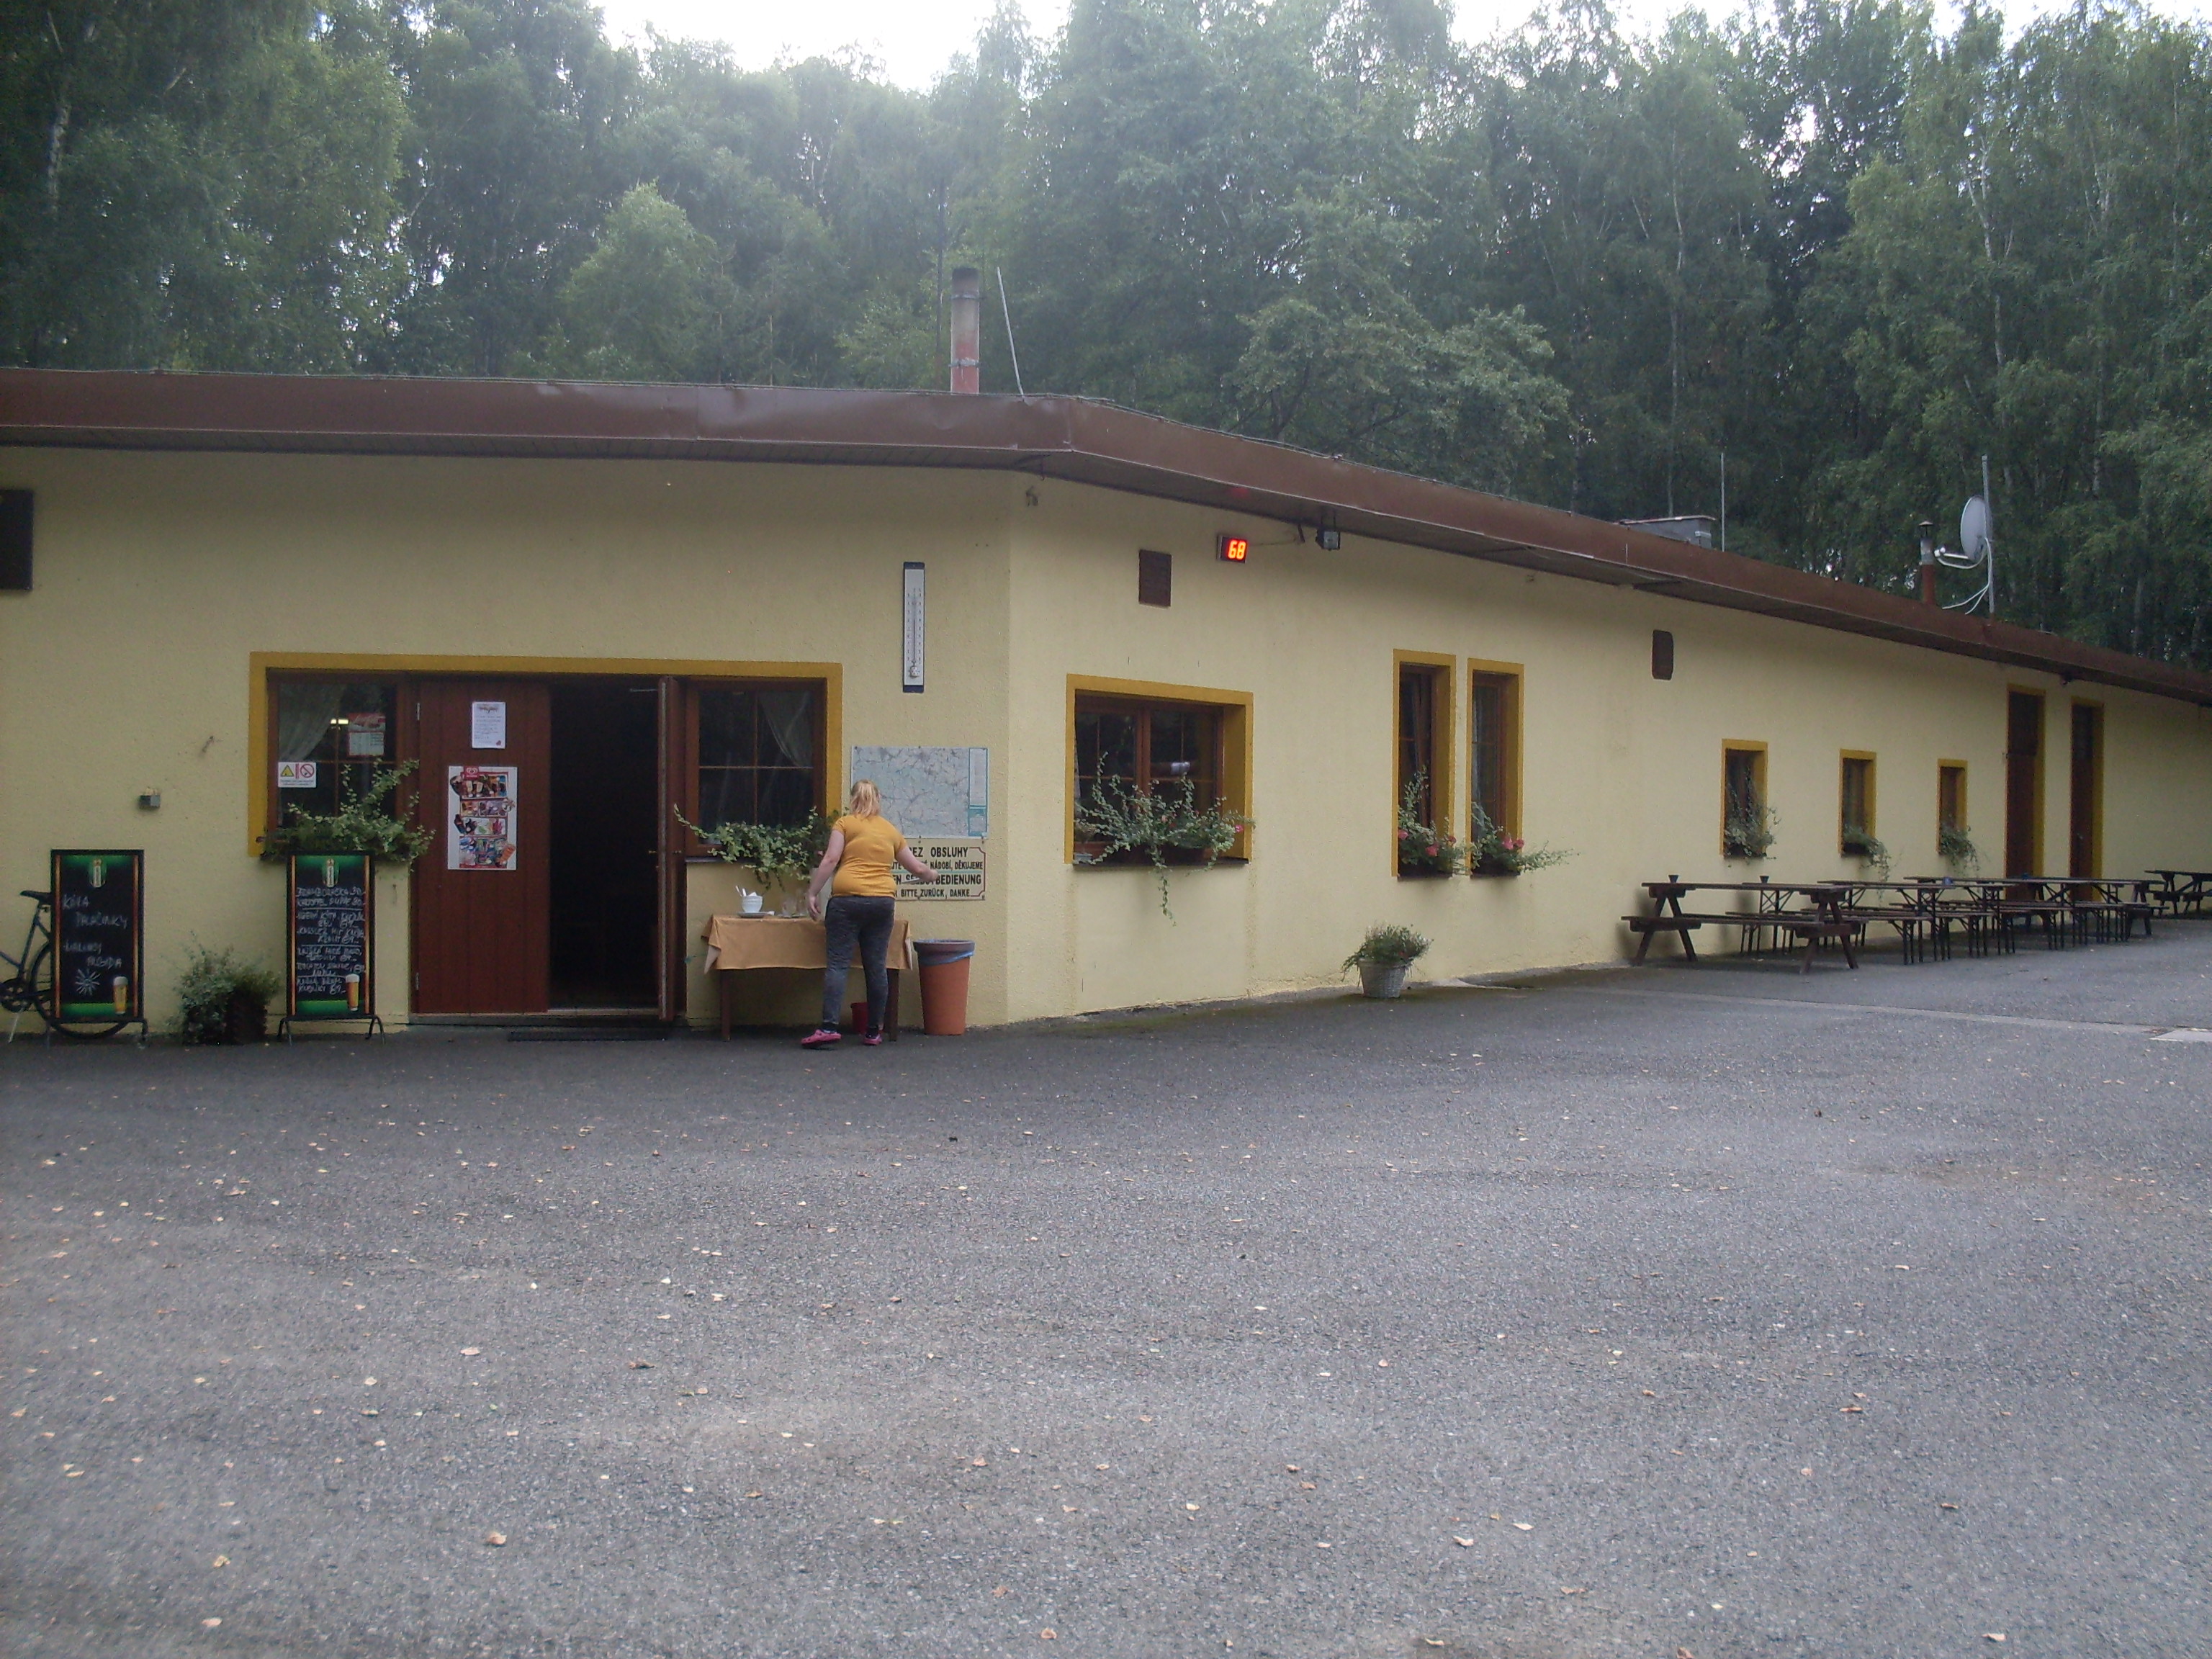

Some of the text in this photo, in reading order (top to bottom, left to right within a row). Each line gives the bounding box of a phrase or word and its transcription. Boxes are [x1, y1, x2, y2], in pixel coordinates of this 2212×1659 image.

[1228, 540, 1246, 559] 68
[930, 847, 968, 857] OBSLUHY
[930, 860, 953, 871] NÁDOBÍ,
[955, 860, 983, 869] DĚKUJEME
[901, 889, 918, 897] BITTE
[950, 889, 969, 897] DANKE
